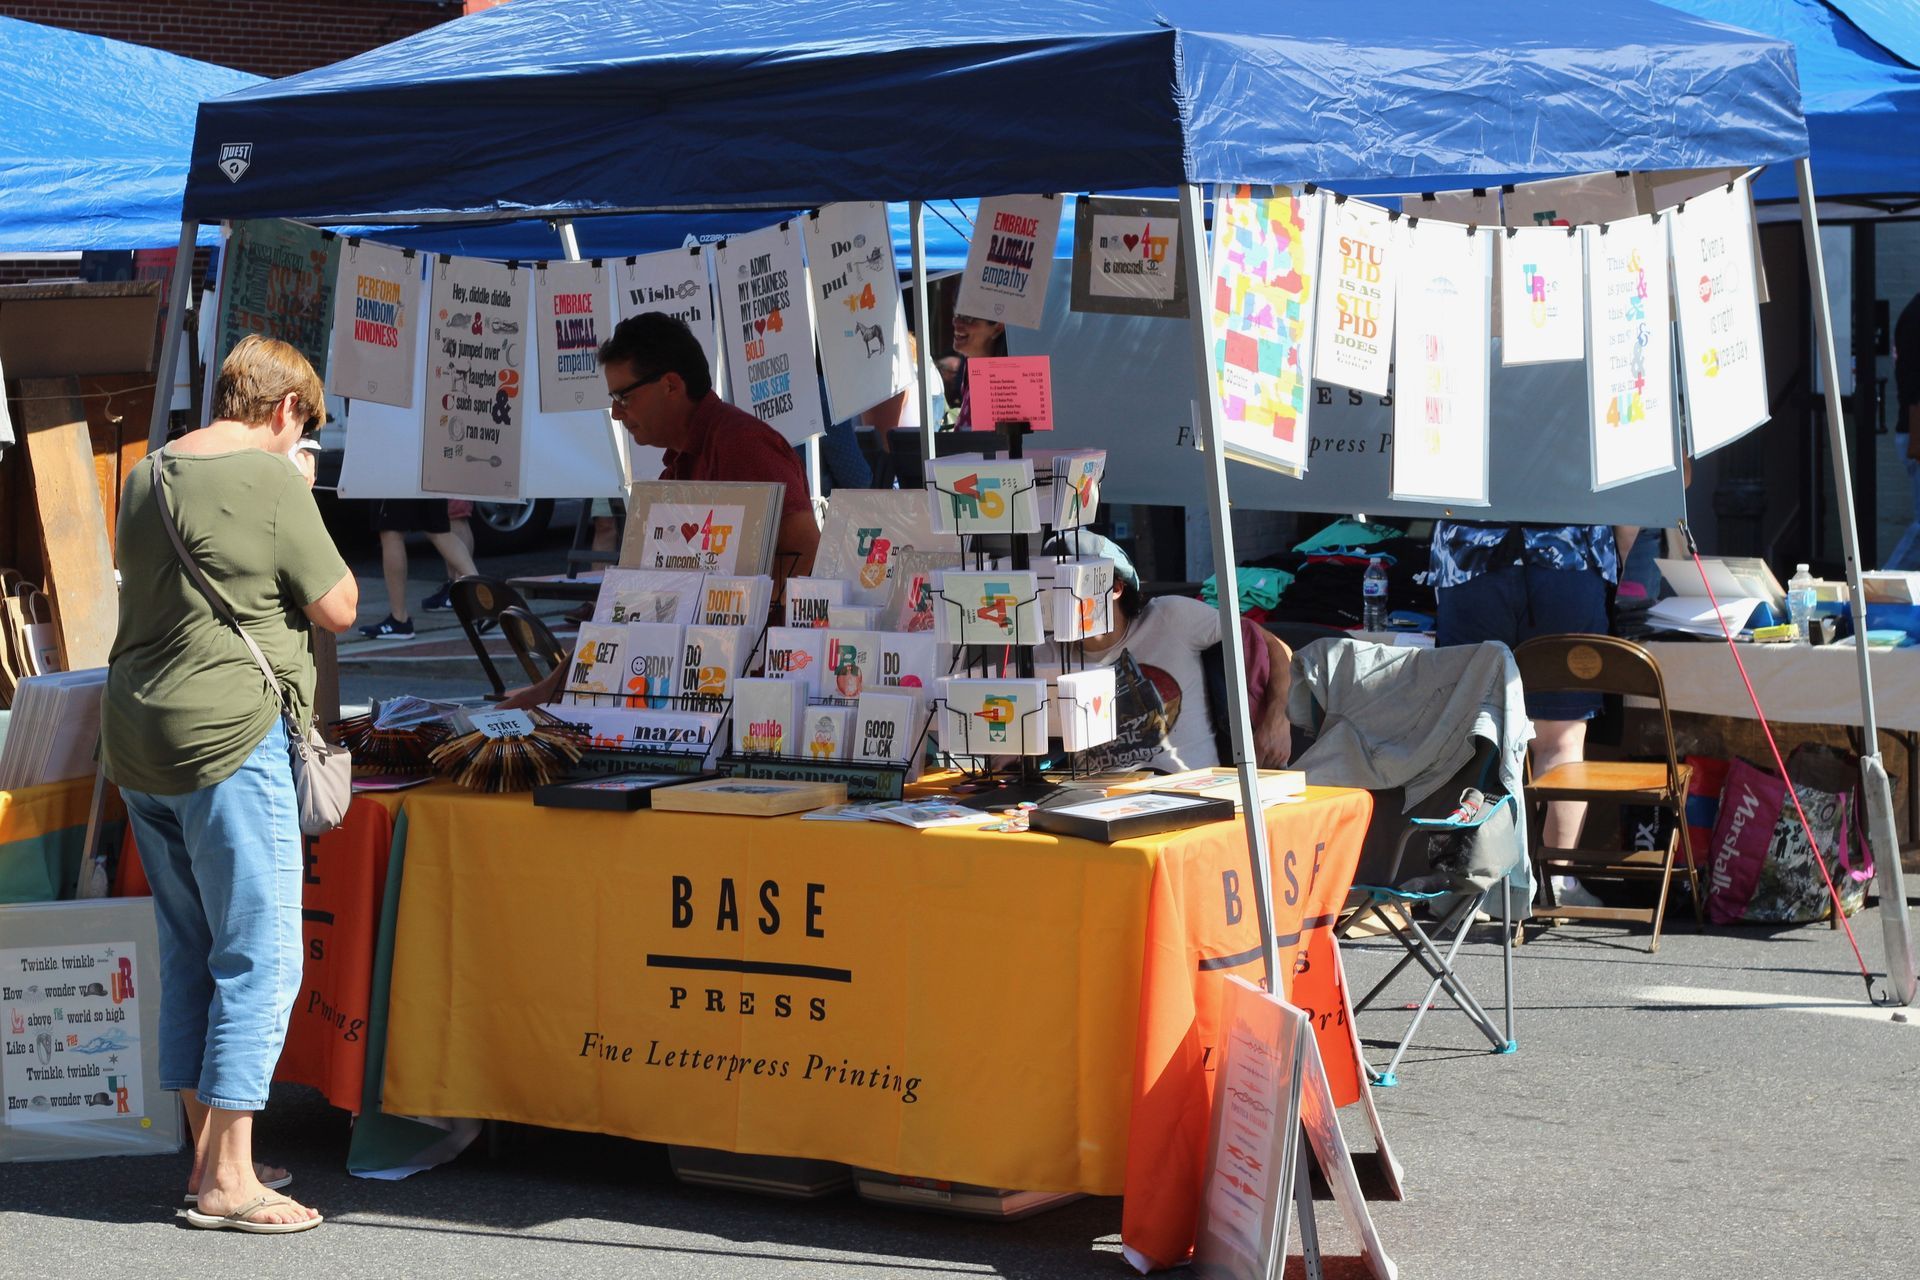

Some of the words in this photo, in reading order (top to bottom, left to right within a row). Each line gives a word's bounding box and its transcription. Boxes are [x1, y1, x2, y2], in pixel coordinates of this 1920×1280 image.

[222, 146, 250, 160] QUEST
[994, 212, 1039, 238] EMBRACE
[831, 240, 852, 258] Do
[1339, 236, 1384, 266] STU
[750, 253, 772, 277] ADMIT
[1342, 256, 1381, 283] PID
[357, 274, 400, 303] PERFORM
[738, 281, 750, 302] MY
[751, 269, 788, 298] WEAKNESS
[822, 272, 848, 300] put
[982, 265, 1028, 292] empathy
[1340, 278, 1356, 292] IS
[1359, 284, 1381, 300] AS
[469, 286, 490, 305] diddle
[491, 289, 511, 307] diddle
[554, 293, 593, 315] EMBRACE
[629, 284, 675, 305] Wish
[740, 302, 752, 323] MY
[753, 289, 790, 318] FONDNESS
[355, 296, 396, 327] RANDOM
[1336, 292, 1381, 321] STU
[354, 319, 398, 348] KINDNESS
[743, 322, 754, 343] MY
[1338, 310, 1377, 339] PID
[458, 340, 483, 360] jumped
[485, 344, 500, 360] over
[745, 338, 765, 362] BOLD
[1334, 334, 1378, 355] DOES
[558, 349, 597, 375] empathy
[748, 353, 790, 384] CONDENSED
[469, 366, 497, 388] laughed
[750, 380, 770, 402] SANS
[770, 372, 790, 396] SERIF
[456, 395, 472, 411] such
[474, 398, 492, 415] sport
[753, 393, 794, 420] TYPEFACES
[466, 425, 479, 440] ran
[480, 427, 500, 445] away
[654, 551, 664, 568] is
[707, 589, 744, 613] DON'T
[792, 598, 829, 622] THANK
[686, 645, 700, 667] DO
[769, 649, 793, 672] NOT
[884, 652, 900, 675] DO
[572, 662, 592, 684] ME
[680, 692, 724, 713] OTHERS
[488, 720, 520, 731] STATE
[750, 720, 782, 738] coulda
[865, 719, 895, 739] GOOD
[1711, 782, 1760, 895] Marshalls
[672, 875, 826, 938] BASE
[62, 955, 95, 970] twinkle
[3, 987, 23, 1000] How
[45, 984, 76, 998] wonder
[669, 986, 827, 1022] PRESS
[28, 1013, 52, 1026] above
[67, 1010, 92, 1023] world
[94, 1012, 103, 1022] so
[106, 1008, 125, 1023] high
[6, 1041, 26, 1055] Like
[29, 1044, 34, 1054] a
[55, 1040, 64, 1052] in
[67, 1064, 100, 1078] twinkle
[579, 1032, 633, 1064] Fine
[645, 1040, 790, 1081] Letterpress
[803, 1054, 922, 1103] Printing
[8, 1096, 28, 1110] How
[50, 1093, 82, 1106] wonder
